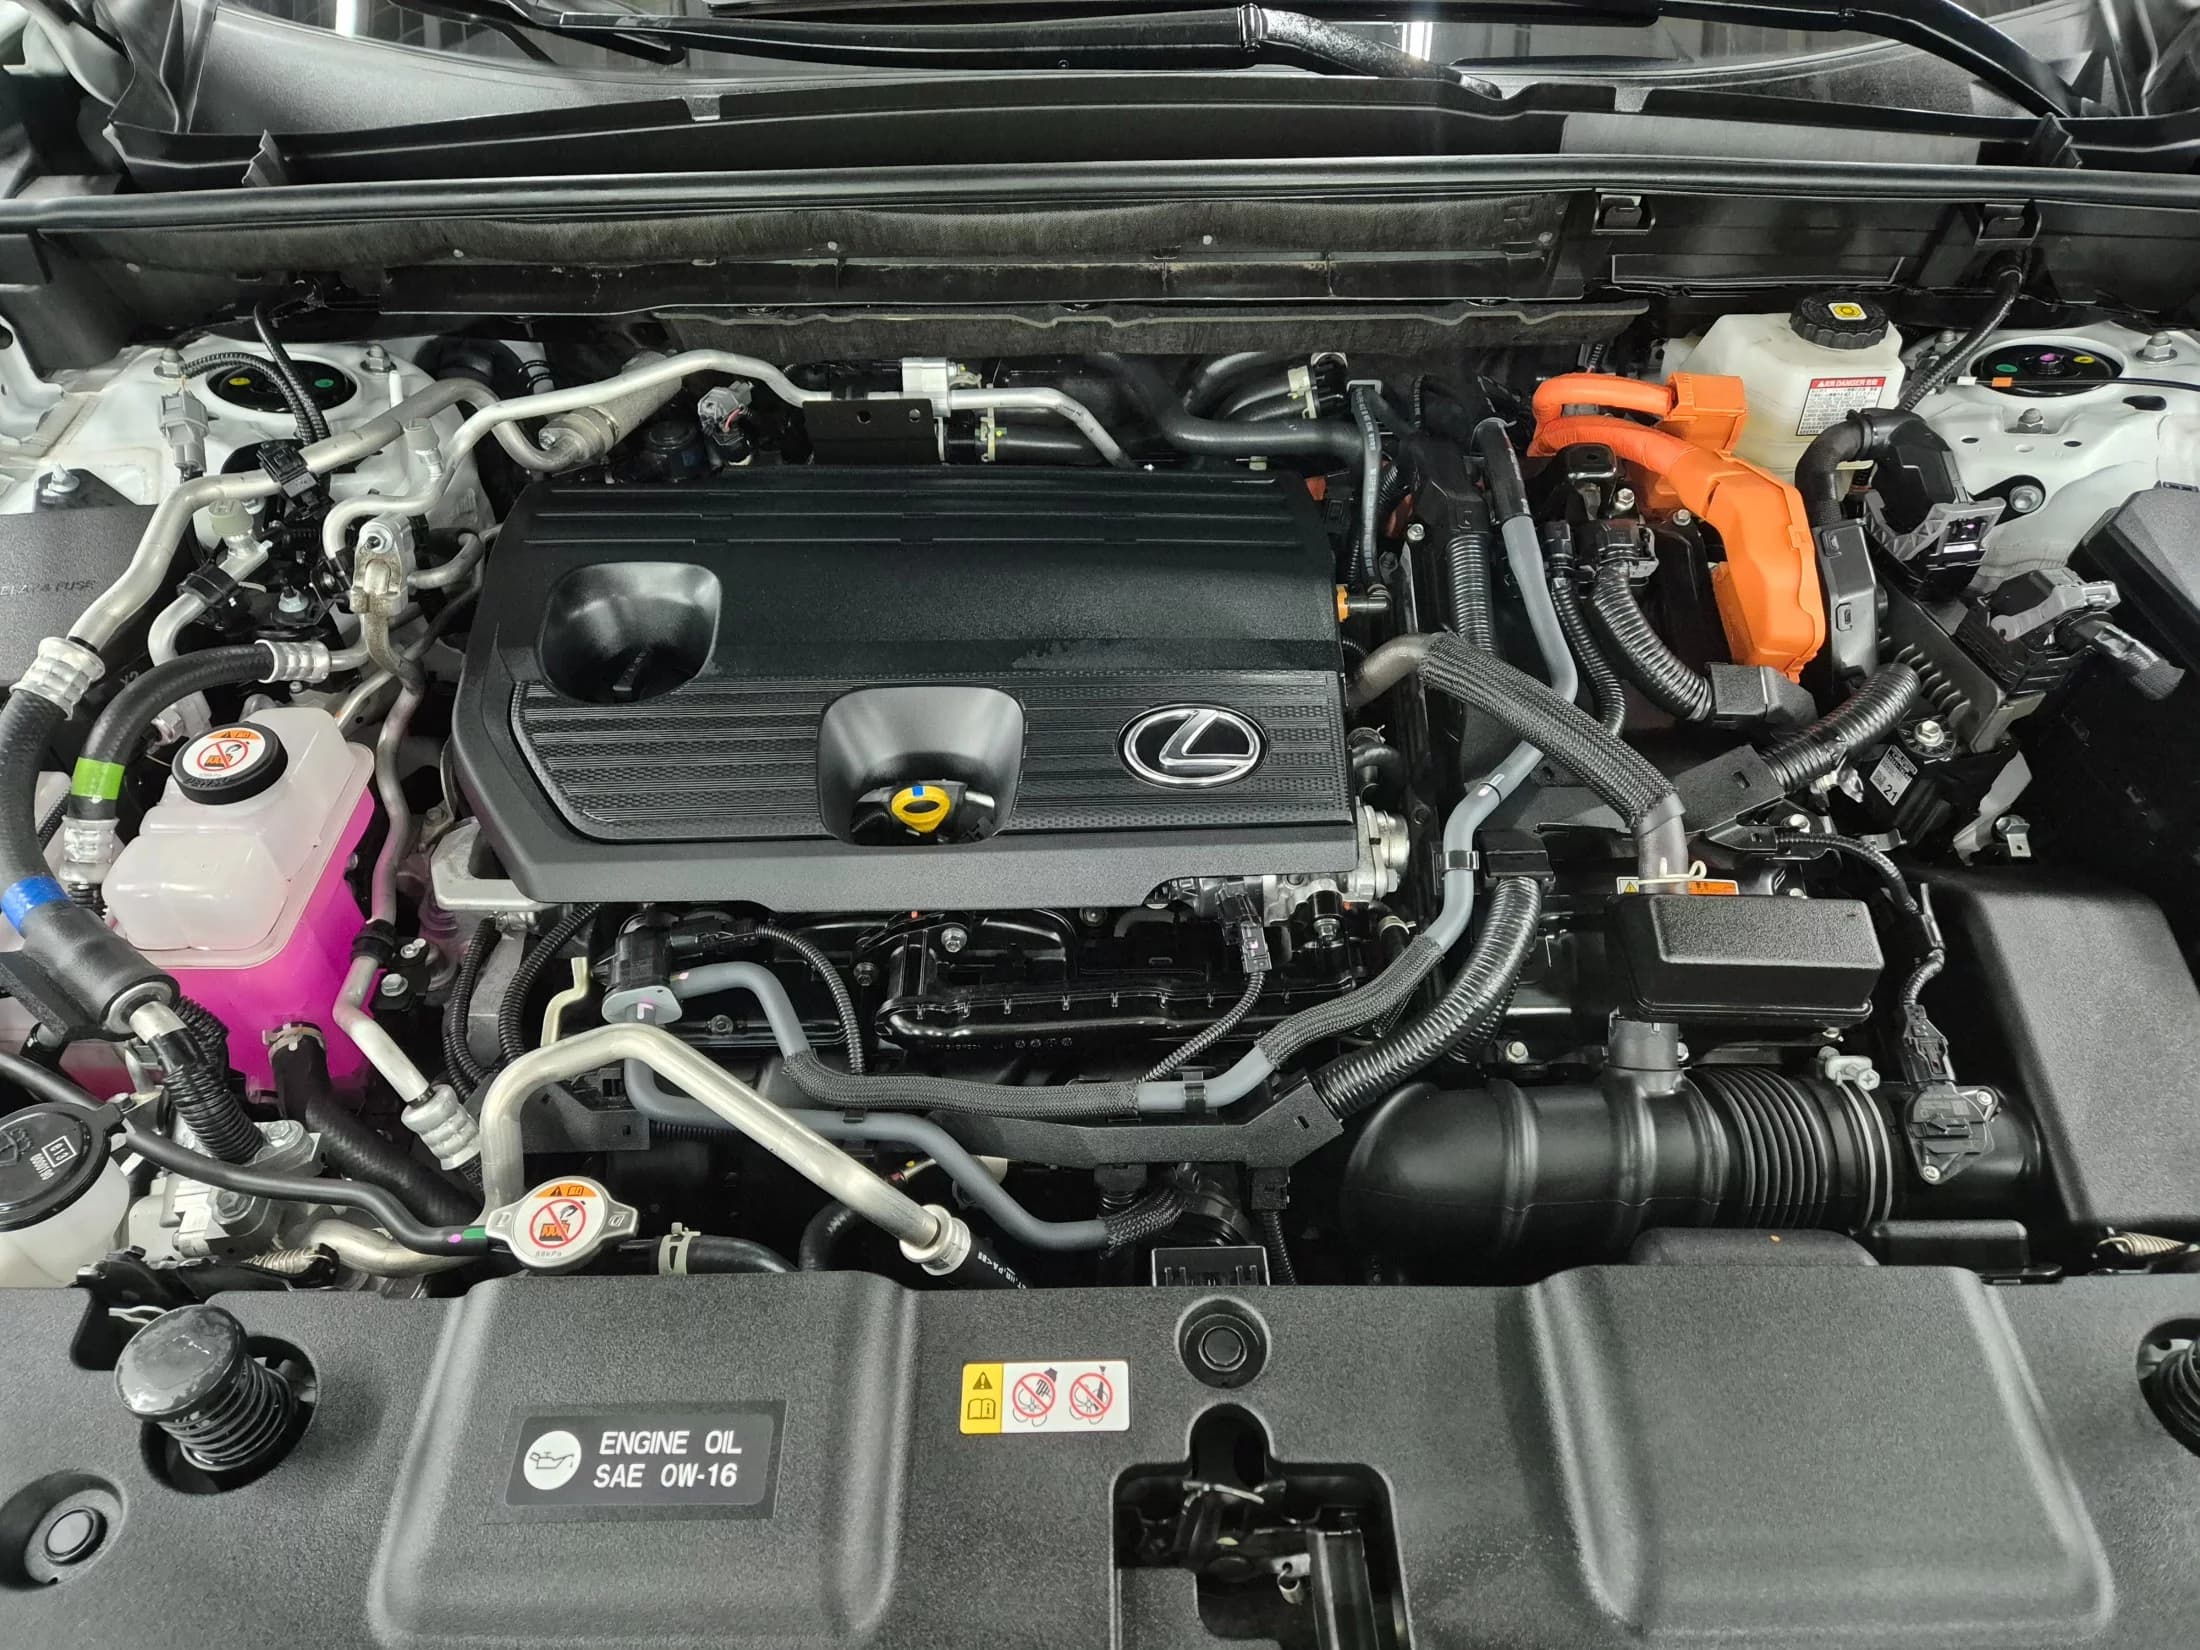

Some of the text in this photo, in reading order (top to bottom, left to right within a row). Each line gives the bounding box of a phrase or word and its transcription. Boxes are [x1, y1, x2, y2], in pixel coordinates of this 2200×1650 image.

[1882, 784, 1898, 801] 21
[599, 1430, 742, 1455] ENGINE OIL
[593, 1462, 738, 1488] SAE 0W-16
